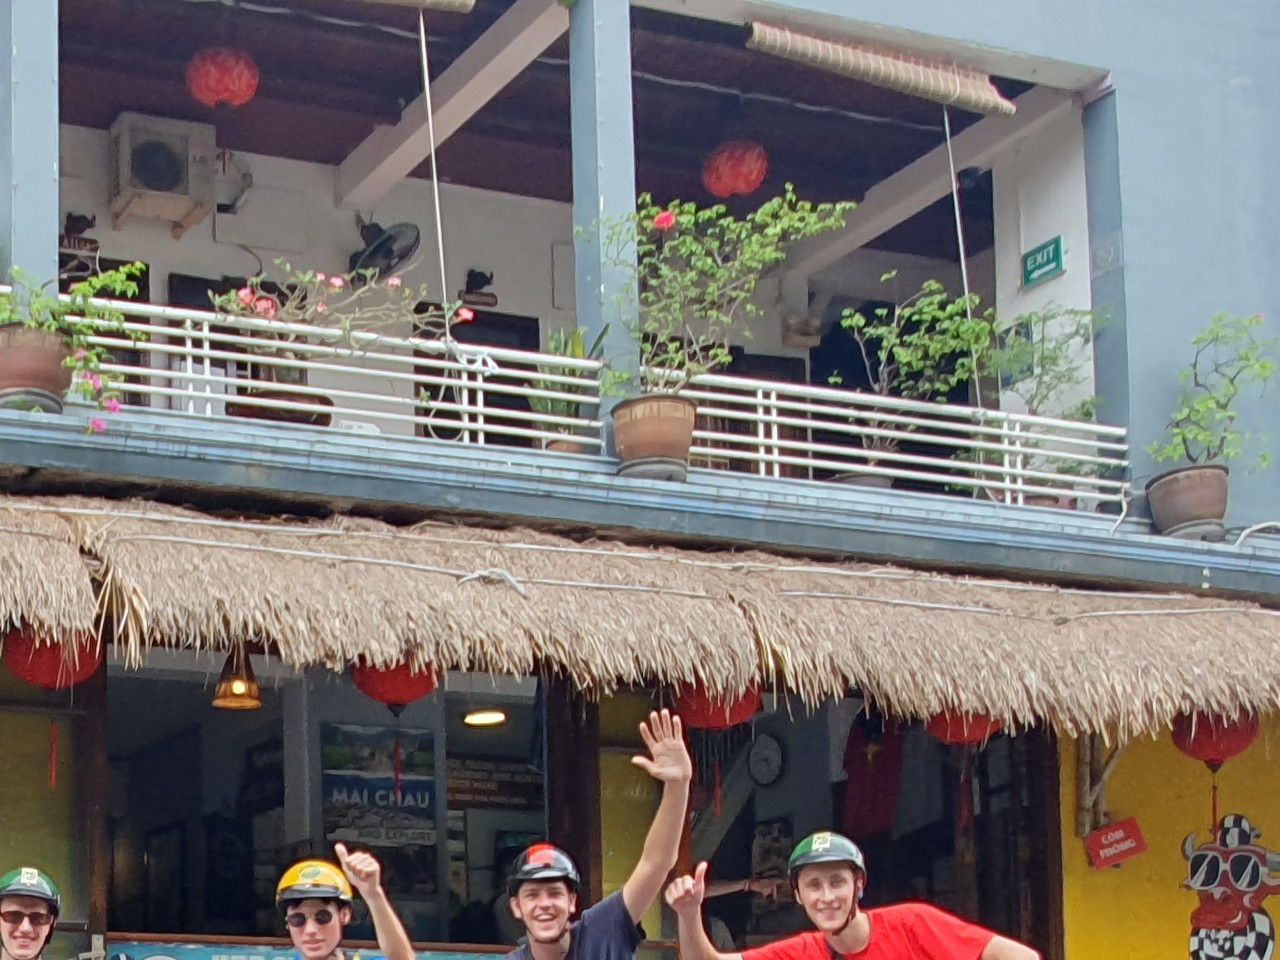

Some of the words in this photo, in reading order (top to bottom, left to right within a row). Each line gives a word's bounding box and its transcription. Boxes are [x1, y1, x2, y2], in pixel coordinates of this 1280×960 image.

[1027, 244, 1055, 270] EXIT
[332, 786, 369, 805] MAI
[375, 788, 430, 809] CHAU
